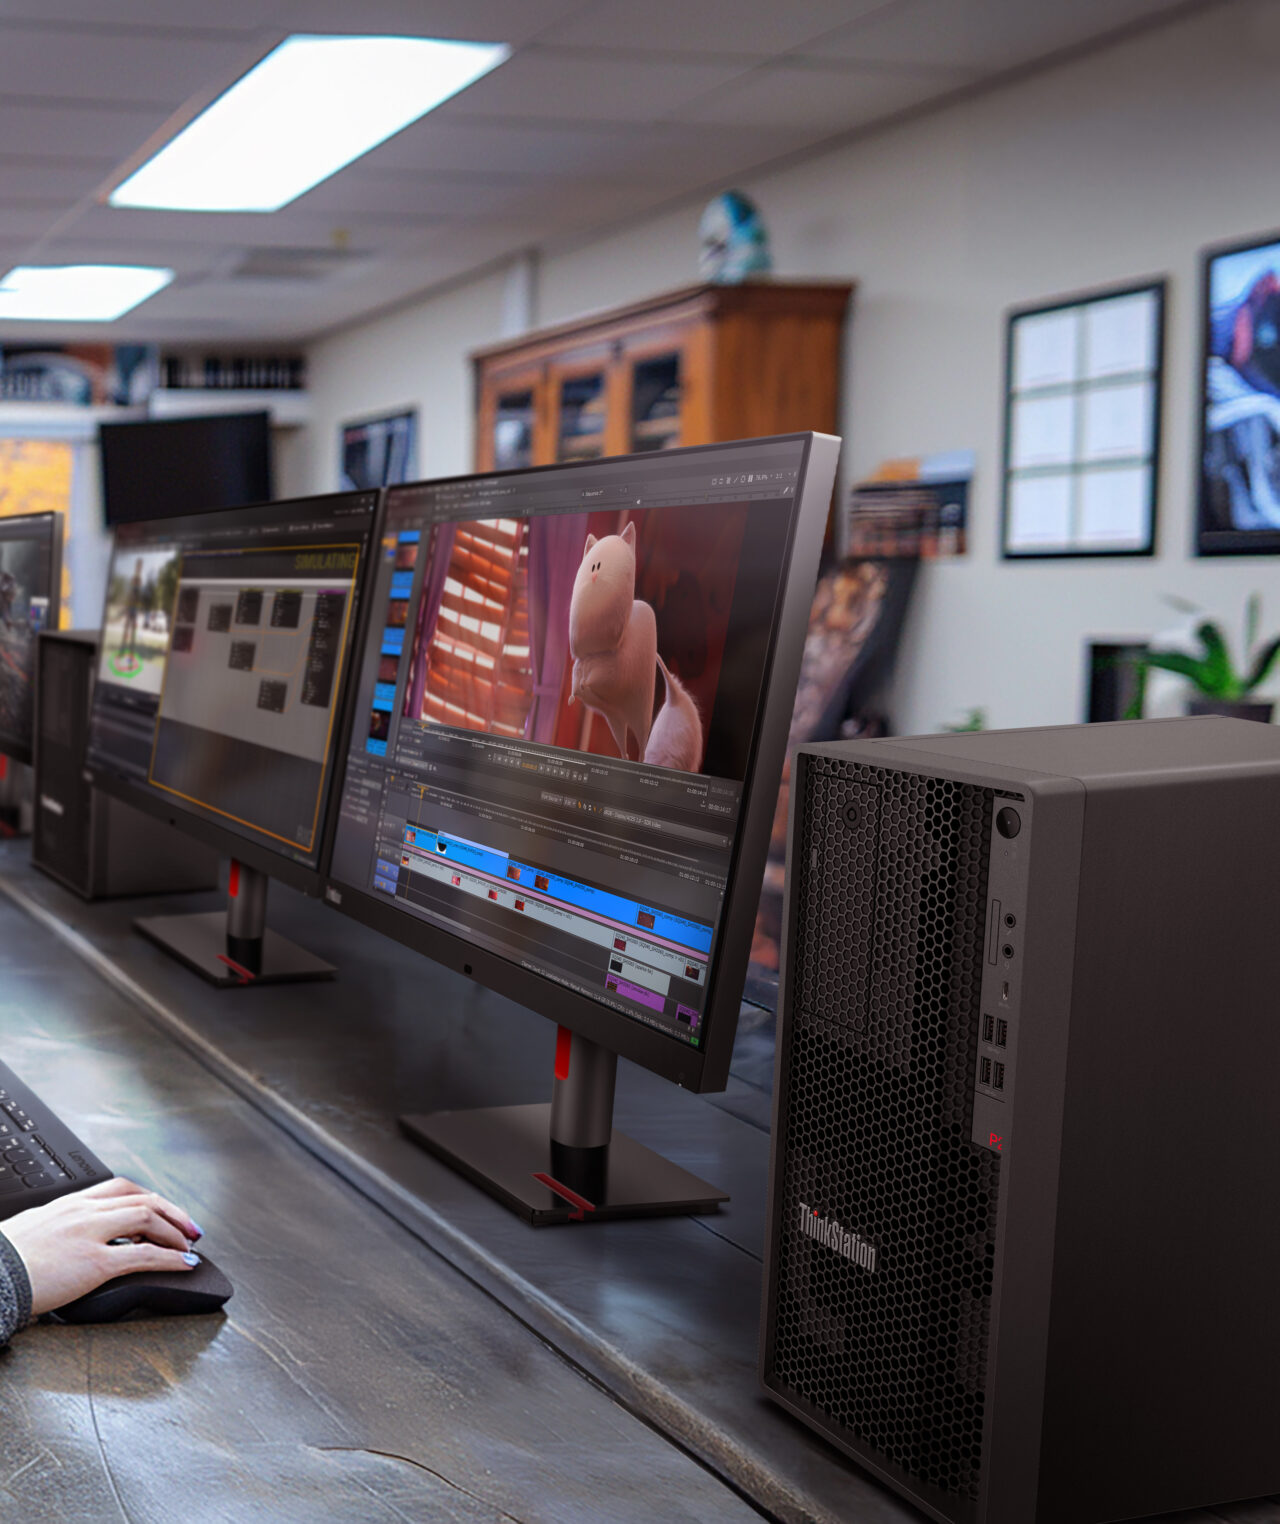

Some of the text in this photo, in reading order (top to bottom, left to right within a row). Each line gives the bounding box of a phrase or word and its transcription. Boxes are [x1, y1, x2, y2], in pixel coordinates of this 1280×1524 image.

[295, 552, 356, 570] SIMULATING
[68, 1150, 97, 1177] Lenovo
[799, 1202, 876, 1273] ThinkStation
